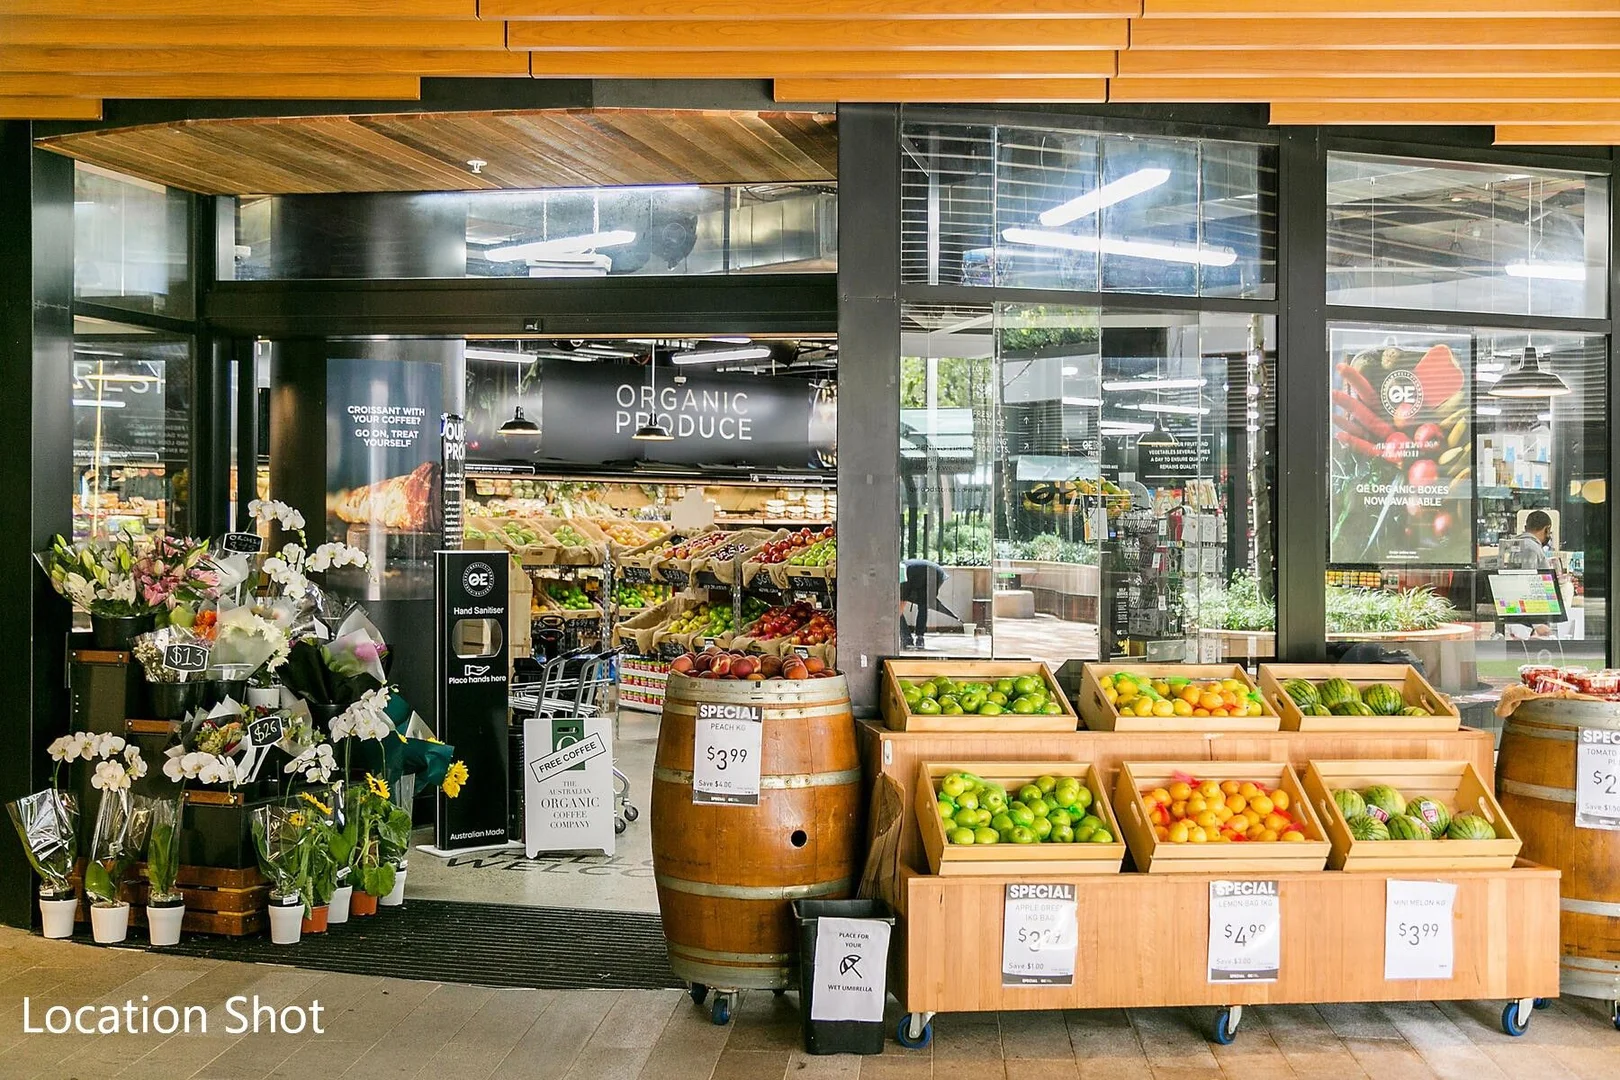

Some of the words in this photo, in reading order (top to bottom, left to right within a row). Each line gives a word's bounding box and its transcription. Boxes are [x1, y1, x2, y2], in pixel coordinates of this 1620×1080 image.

[616, 384, 748, 415] ORGANIC
[347, 406, 401, 415] CROISSANT
[403, 407, 425, 416] WITH
[353, 415, 379, 424] YOUR
[381, 416, 421, 425] COFFEE?
[615, 410, 753, 441] PRODUCE
[355, 429, 370, 438] GO
[372, 430, 389, 440] ON,
[391, 430, 419, 439] TREAT
[363, 439, 412, 448] YOURSELF
[1356, 484, 1370, 493] QE
[1371, 484, 1415, 494] ORGANIC
[1417, 485, 1449, 495] BOXES
[1364, 497, 1387, 506] NOW
[1389, 497, 1442, 507] AVAILABLE
[453, 607, 473, 615] Hand
[474, 606, 505, 615] Sanitiser
[169, 646, 205, 667] $13
[448, 677, 468, 685] Place
[468, 675, 491, 684] hands
[490, 675, 507, 683] here
[699, 704, 759, 720] SPECIAL
[710, 723, 735, 731] PEACH
[254, 721, 278, 744] $26
[538, 757, 562, 773] FREE
[562, 741, 597, 762] COFFEE
[1586, 748, 1617, 757] TOMATO
[549, 788, 592, 796] AUSTRALIAN
[541, 797, 600, 809] ORGANIC
[1585, 803, 1602, 811] Save
[553, 810, 588, 819] COFFEE
[549, 820, 591, 829] COMPANY
[450, 830, 485, 840] Australian
[485, 828, 505, 837] Made
[1009, 884, 1072, 899] SPECIAL
[1214, 881, 1276, 896] SPECIAL
[1015, 904, 1039, 912] APPLE
[1040, 904, 1063, 912] GREE
[1218, 899, 1243, 908] LEMON
[1410, 899, 1434, 907] MELON
[1008, 962, 1025, 970] Save
